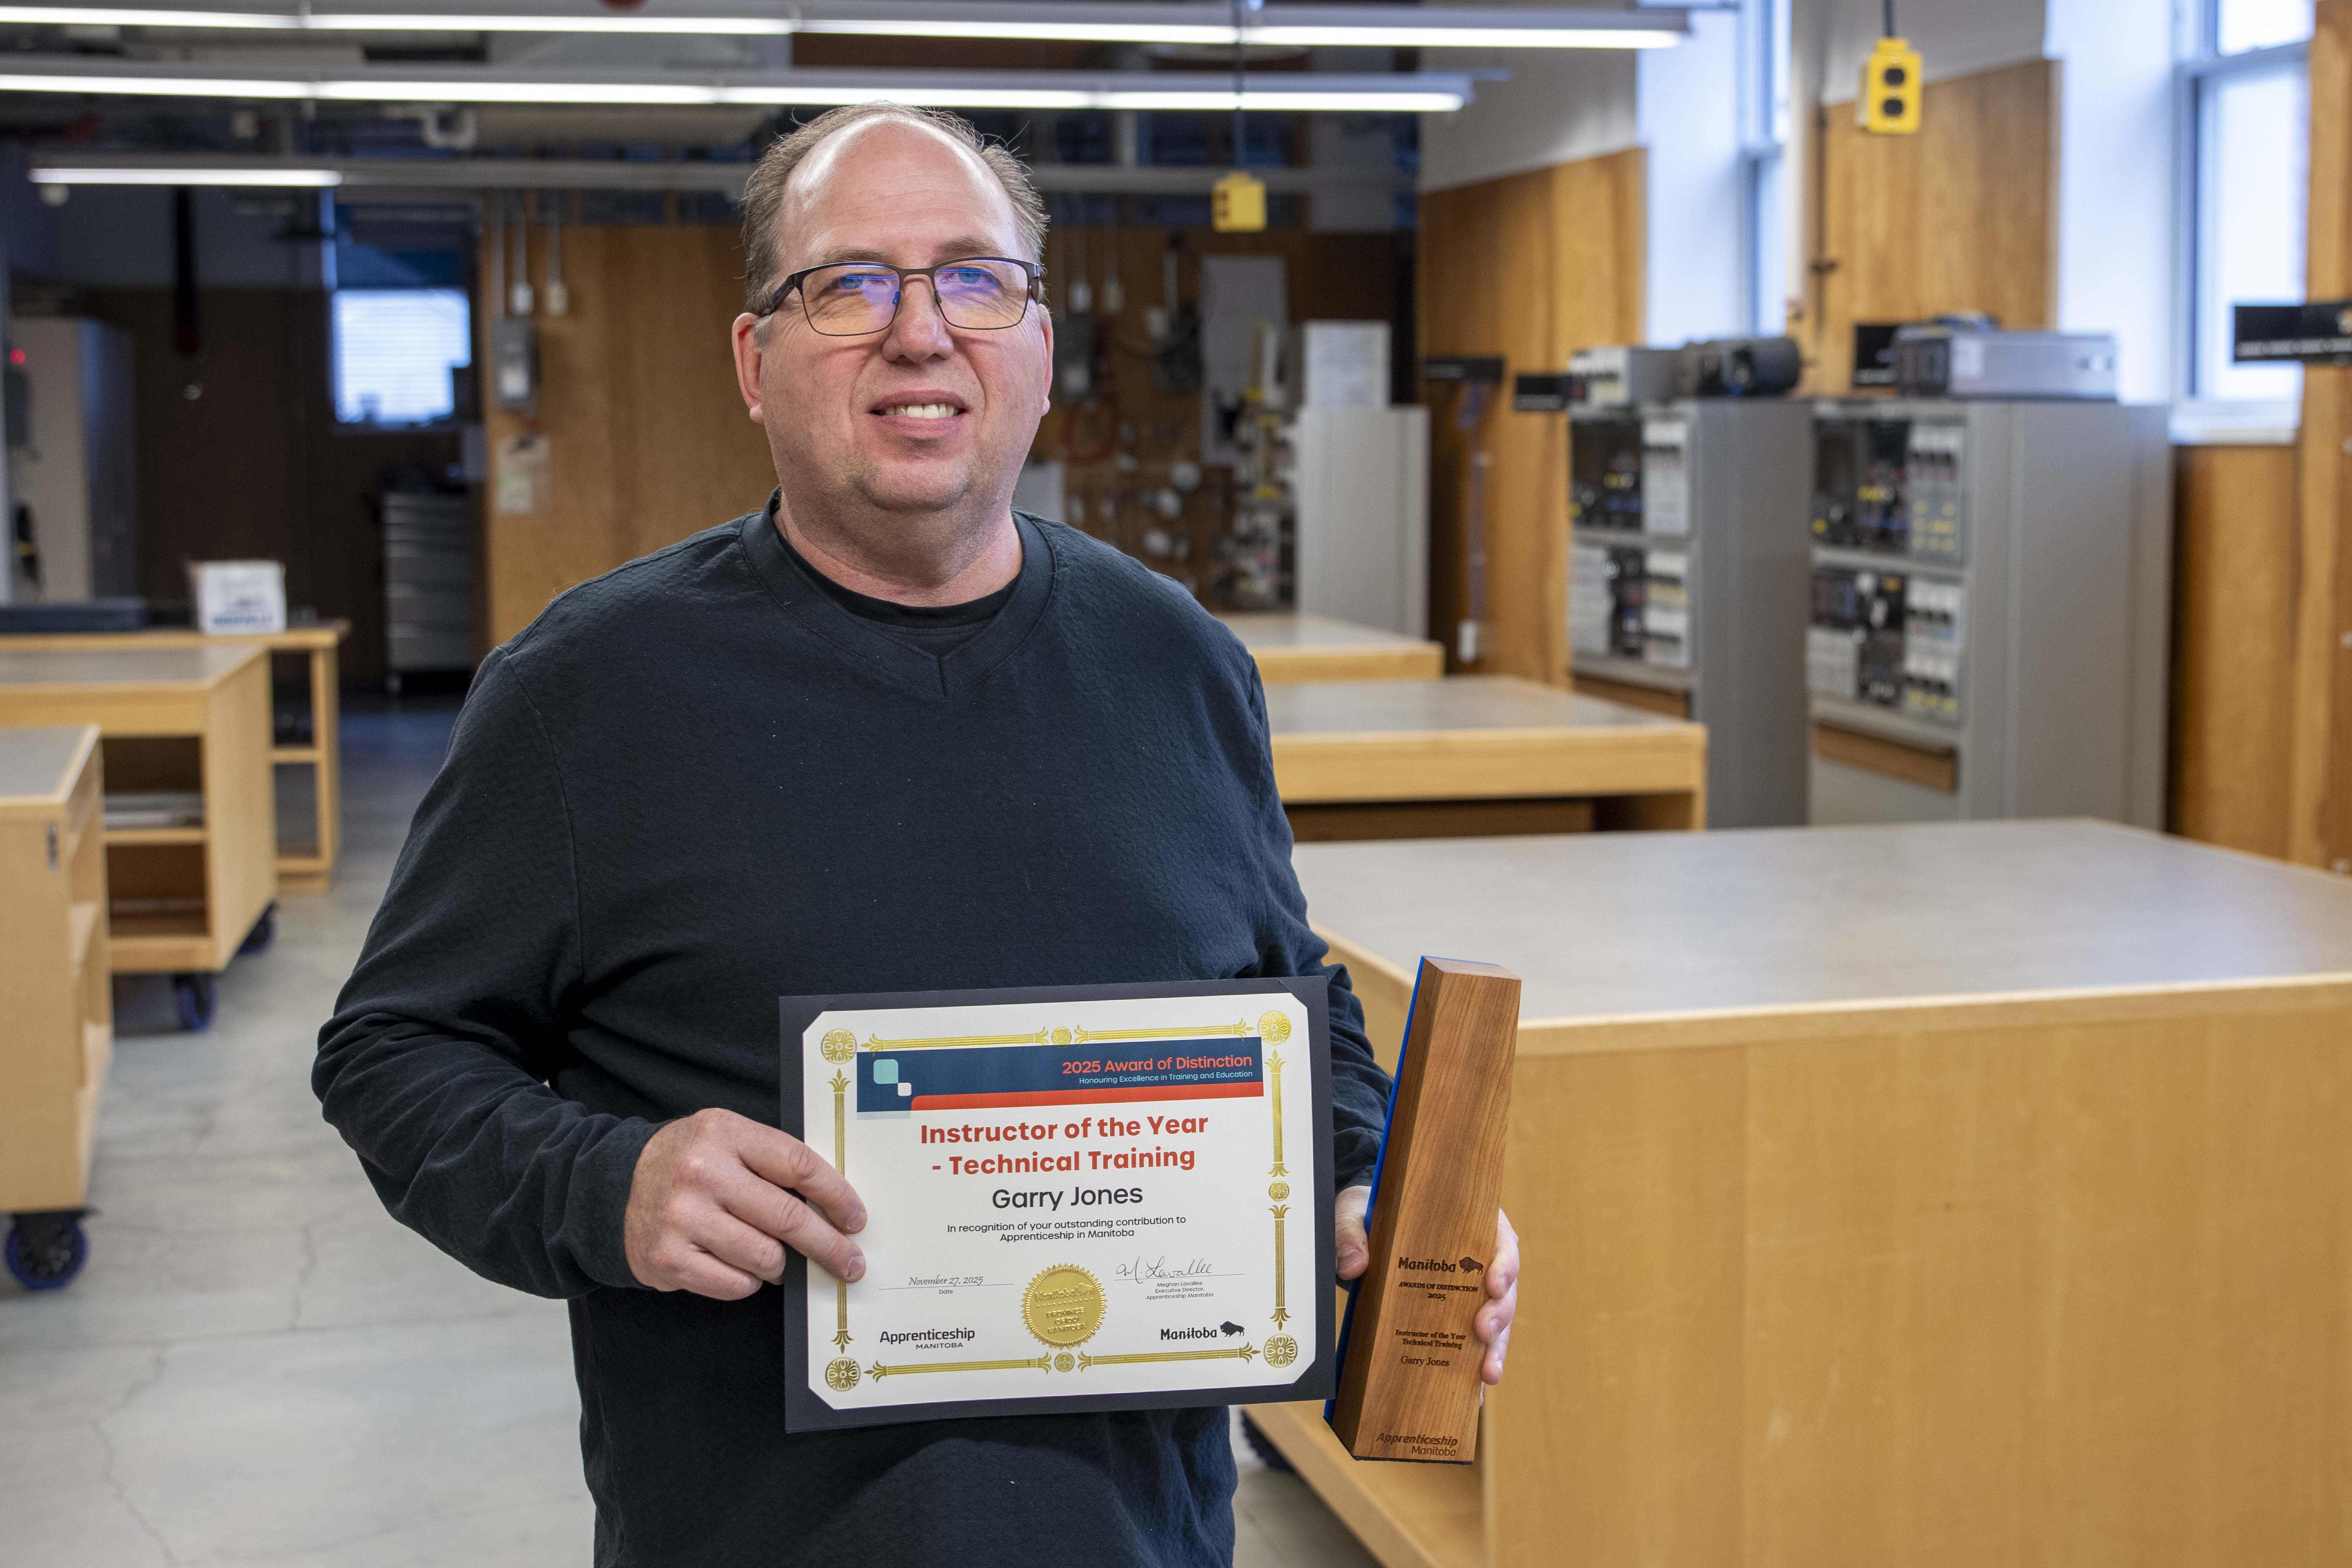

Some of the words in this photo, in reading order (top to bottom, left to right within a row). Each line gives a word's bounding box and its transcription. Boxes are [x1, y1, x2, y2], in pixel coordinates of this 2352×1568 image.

[1063, 1061, 1101, 1074] 2025
[1104, 1058, 1153, 1072] Award
[1157, 1057, 1172, 1070] of
[1176, 1055, 1252, 1069] Distinction
[922, 1123, 1058, 1143] Instructor
[1065, 1118, 1091, 1138] of
[1098, 1117, 1140, 1137] the
[1147, 1116, 1208, 1134] Year
[949, 1151, 1079, 1174] Technical
[1088, 1146, 1194, 1170] Training
[993, 1189, 1063, 1211] Garry
[1071, 1187, 1143, 1205] Jones
[959, 1223, 1014, 1233] recognition
[1017, 1221, 1028, 1230] of
[1029, 1223, 1052, 1231] your
[1054, 1219, 1113, 1229] outstanding
[1116, 1216, 1174, 1226] contribution
[1000, 1231, 1074, 1243] Apprenticeship
[1088, 1229, 1134, 1238] Manitoba
[1398, 1257, 1456, 1273] Manitoba
[908, 1274, 948, 1286] November
[949, 1277, 960, 1287] 27,
[963, 1276, 984, 1286] 2025
[1436, 1284, 1479, 1292] DISTINCTION
[1427, 1293, 1446, 1301] 2025
[1047, 1307, 1085, 1318] PROVINCE
[1047, 1323, 1087, 1334] MANITOBA
[1161, 1327, 1217, 1340] Manitoba
[1395, 1329, 1429, 1338] Instructor
[880, 1327, 975, 1345] Apprenticeship
[1434, 1340, 1463, 1350] Training
[1401, 1356, 1426, 1367] Garry
[1426, 1357, 1450, 1367] Jones
[1375, 1432, 1458, 1448] Apprenticeship
[1411, 1445, 1456, 1456] Manitoba
